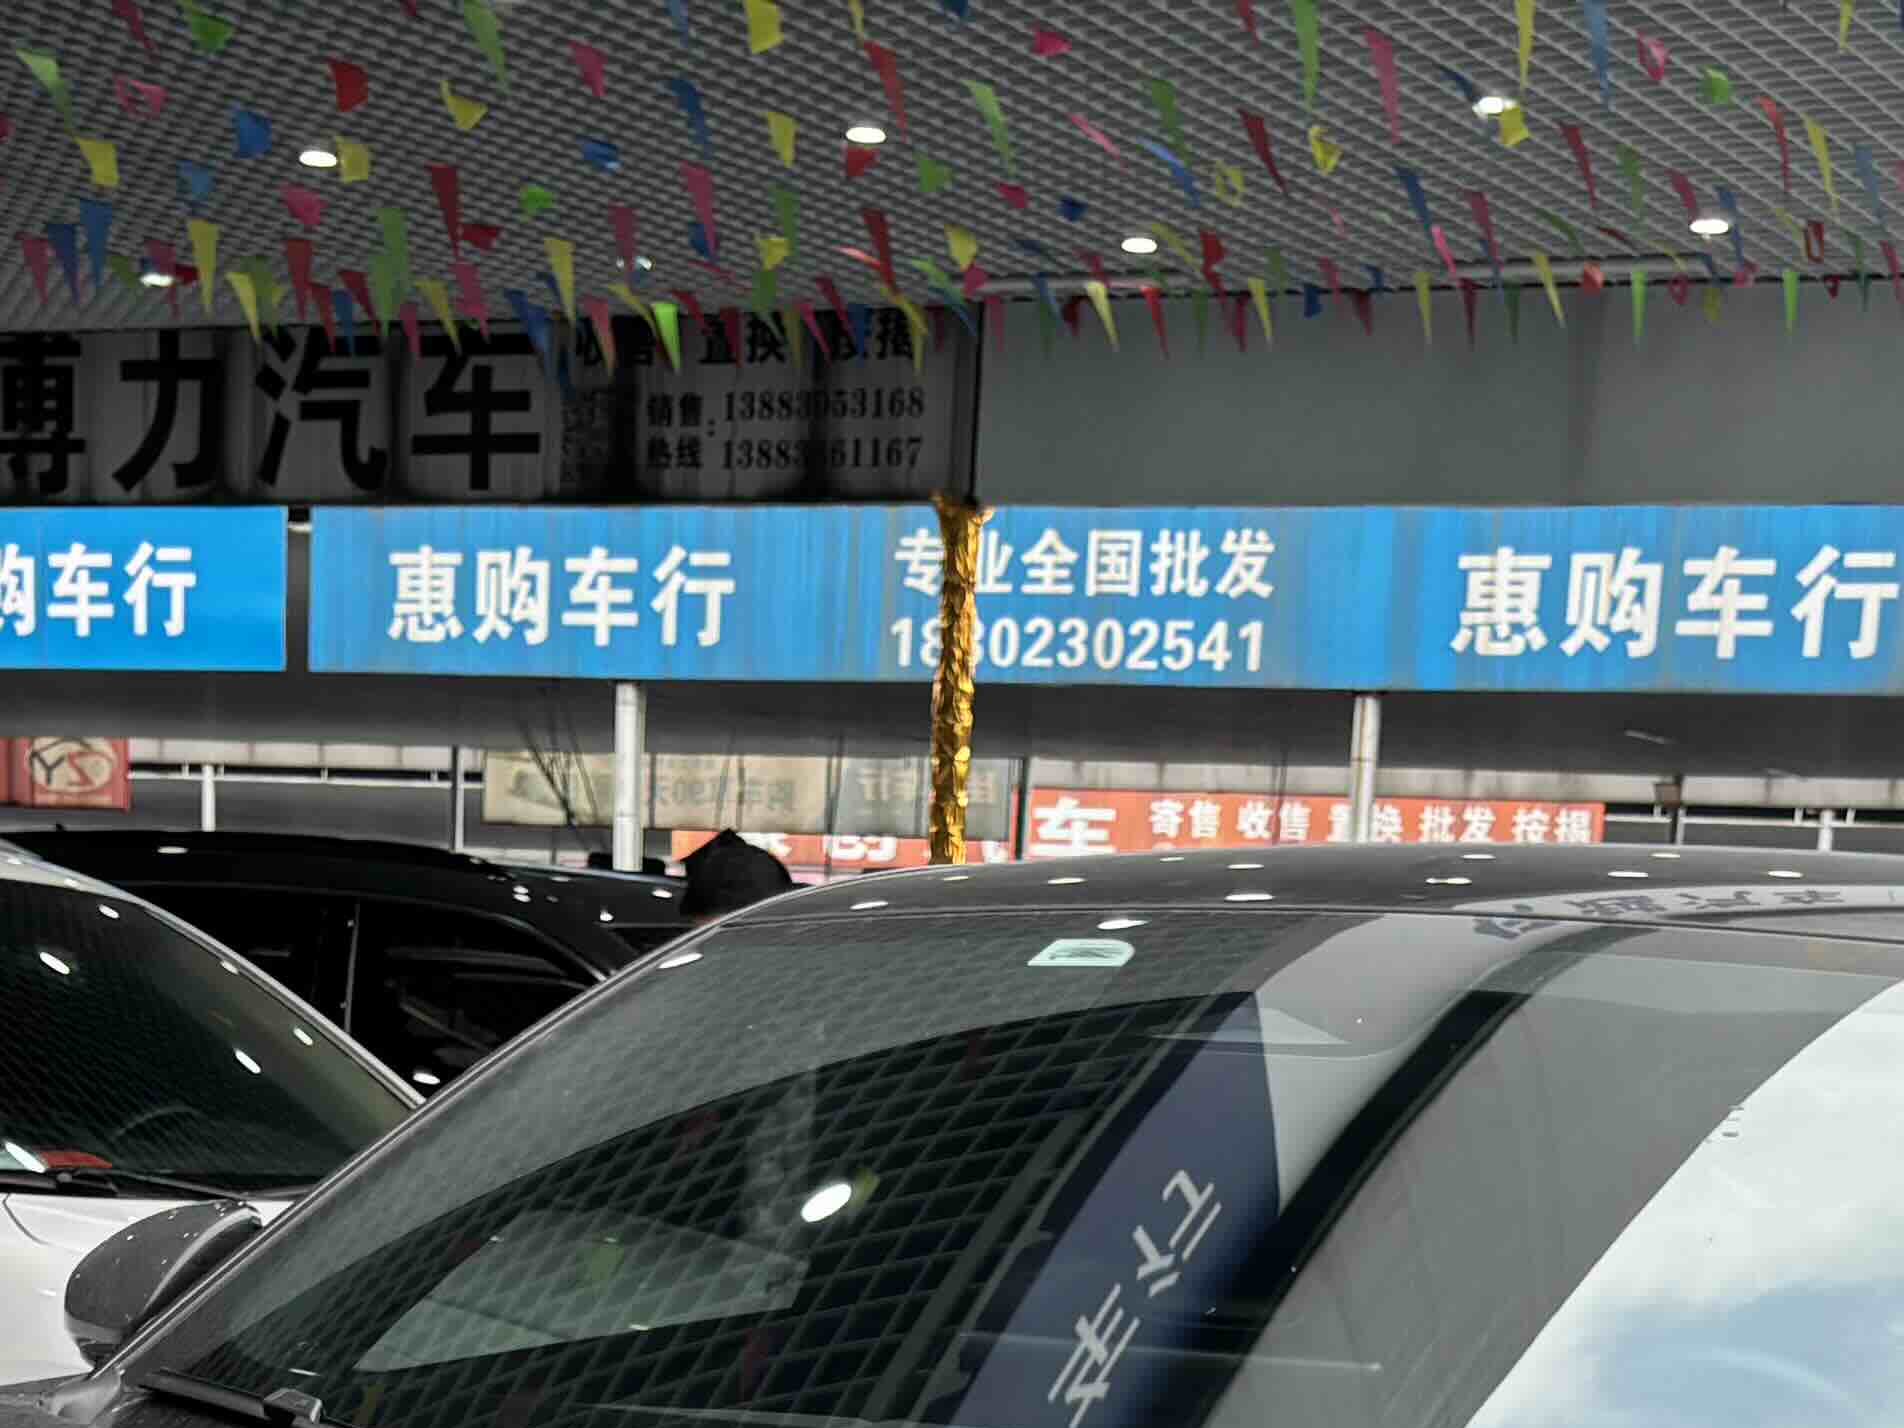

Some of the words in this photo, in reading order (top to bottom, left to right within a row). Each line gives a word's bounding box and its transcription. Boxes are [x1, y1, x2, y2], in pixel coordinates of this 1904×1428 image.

[387, 544, 736, 646] 惠购车行
[1450, 546, 1899, 660] 惠购车行
[890, 617, 1265, 673] 1802302541
[1031, 796, 1117, 855] 车
[1419, 805, 1497, 845] 批发
[1512, 808, 1592, 845] 按揭
